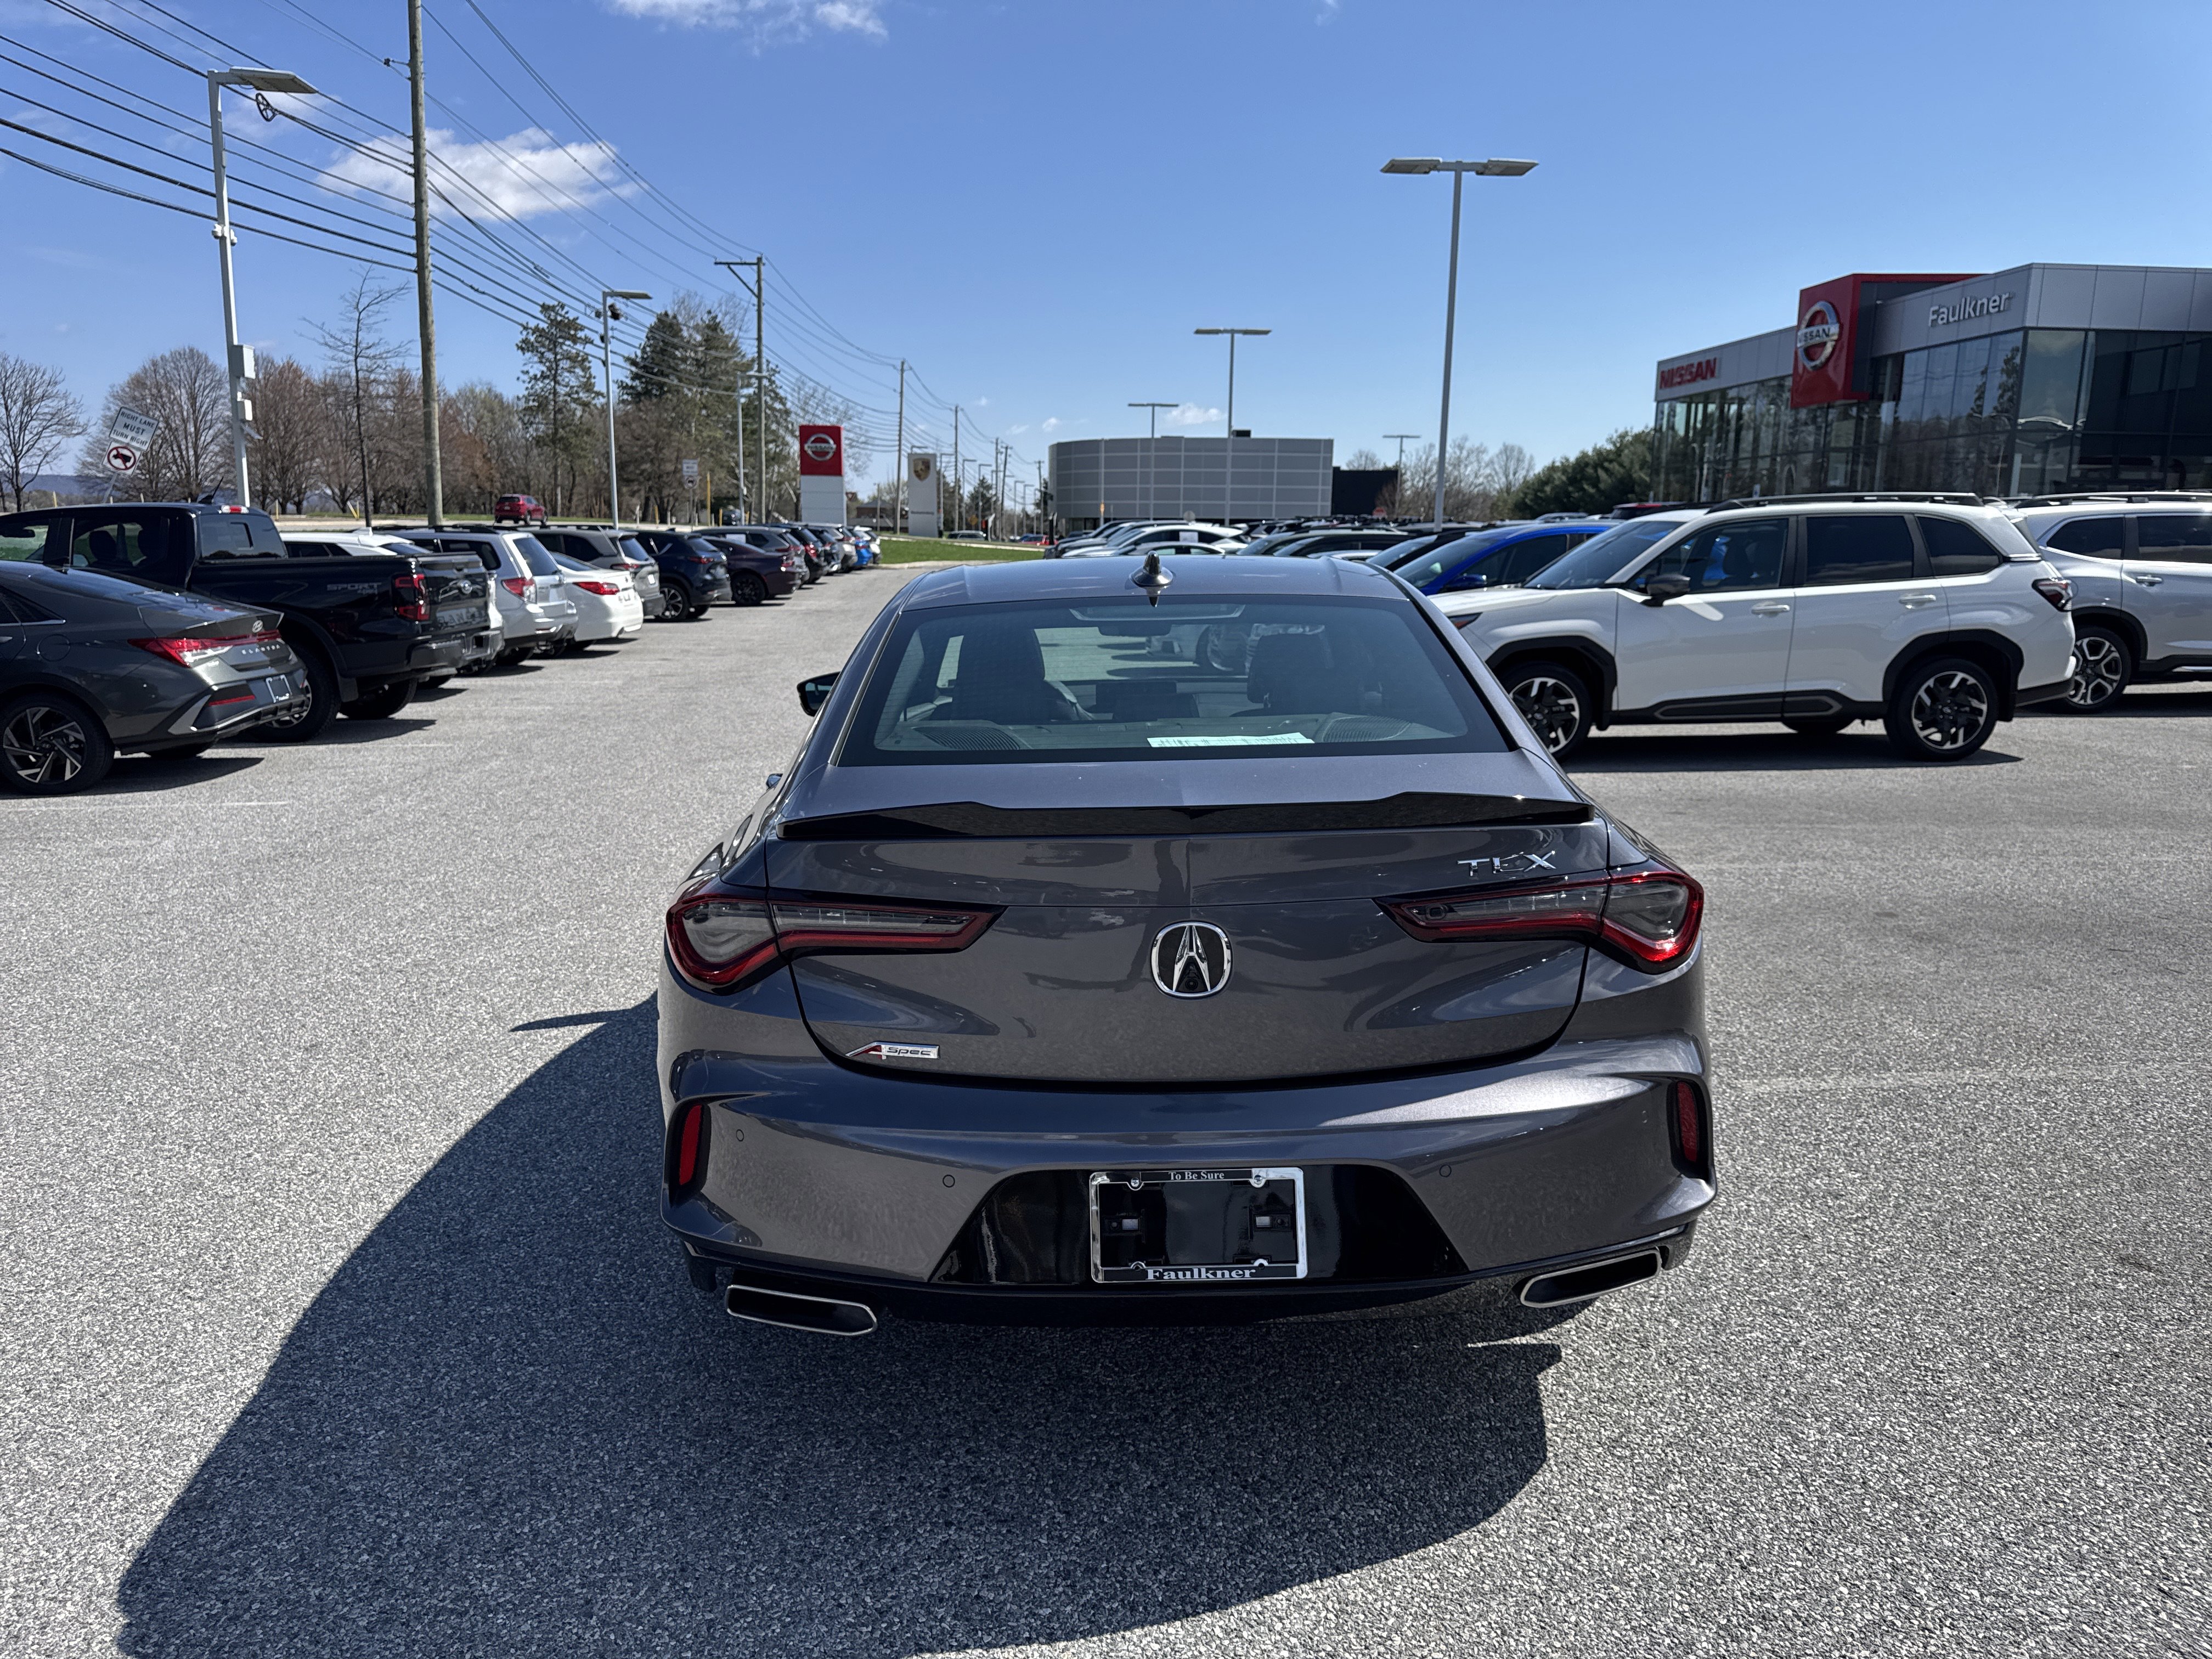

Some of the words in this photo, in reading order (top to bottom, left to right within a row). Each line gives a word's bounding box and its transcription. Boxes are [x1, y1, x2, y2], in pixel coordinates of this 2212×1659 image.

[1928, 292, 2010, 327] Faulkner
[1659, 357, 1717, 389] NISSAN
[121, 411, 138, 422] RIGHT
[139, 419, 155, 428] LANE
[123, 422, 145, 436] MUST
[113, 429, 129, 439] TURN
[130, 436, 148, 447] RIGHT
[327, 582, 382, 591] SPORT
[1457, 851, 1556, 877] TLX
[1169, 1171, 1181, 1180] To
[1184, 1171, 1198, 1180] Be
[1200, 1171, 1224, 1180] Sure
[1146, 1268, 1256, 1280] Faulkner
